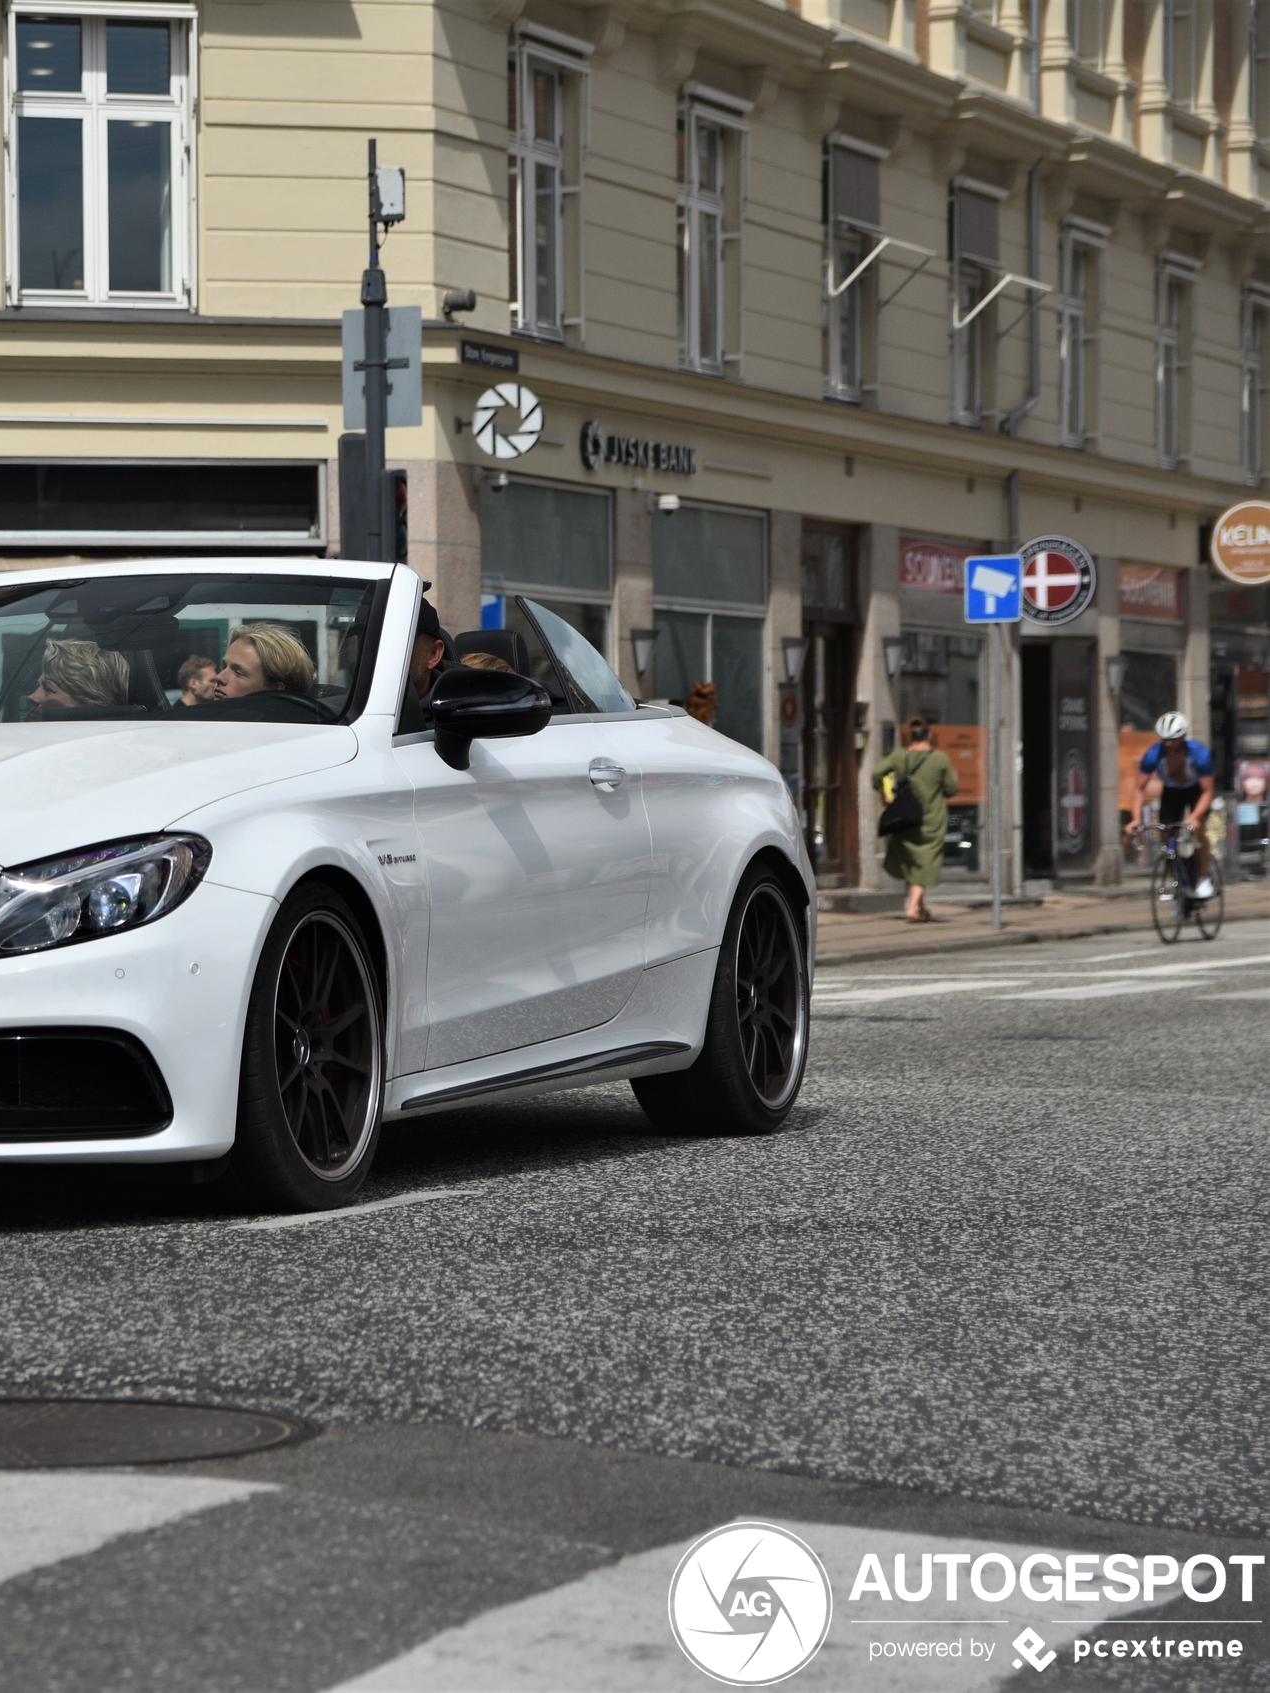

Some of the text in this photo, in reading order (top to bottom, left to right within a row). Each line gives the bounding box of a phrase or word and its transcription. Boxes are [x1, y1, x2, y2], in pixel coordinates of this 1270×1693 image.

[607, 434, 698, 474] JYSKE BANK
[1021, 540, 1088, 569] OPENHAGEN
